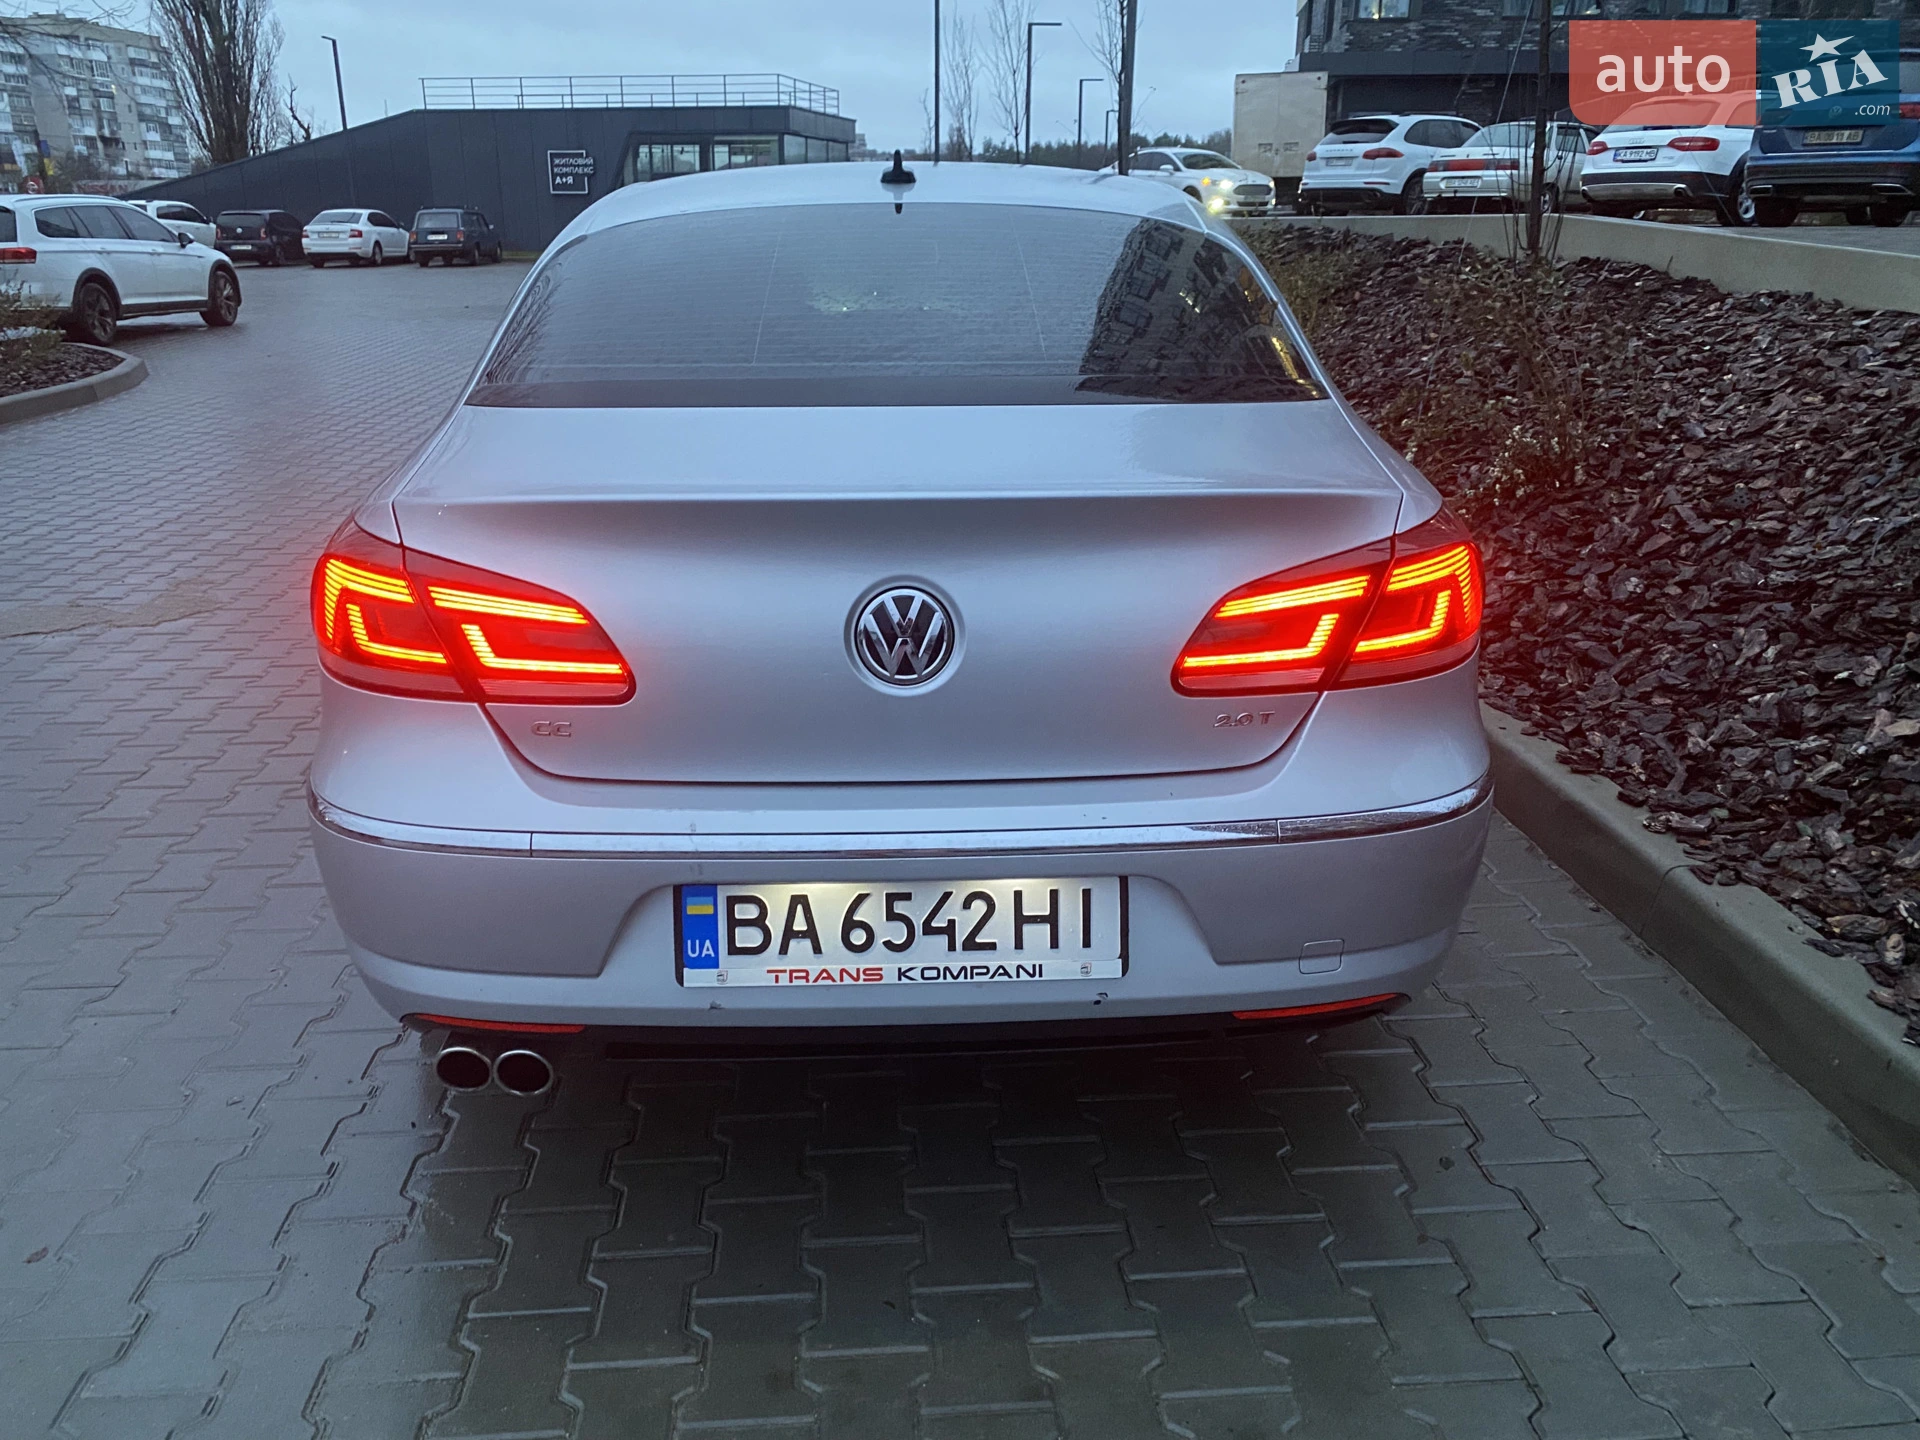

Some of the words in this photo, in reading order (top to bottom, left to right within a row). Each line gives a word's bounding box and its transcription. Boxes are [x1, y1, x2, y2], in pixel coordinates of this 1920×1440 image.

[553, 157, 594, 165] ЖИТЛОВИЙ
[553, 166, 594, 174] КОМПЛЕКС
[531, 720, 572, 737] CC
[1213, 712, 1254, 728] 2.0
[726, 894, 822, 955] BA
[840, 890, 997, 953] 6542
[1013, 887, 1091, 949] HI
[687, 939, 715, 957] UA
[766, 967, 884, 984] TRANS
[897, 963, 1043, 982] KOMPANI
